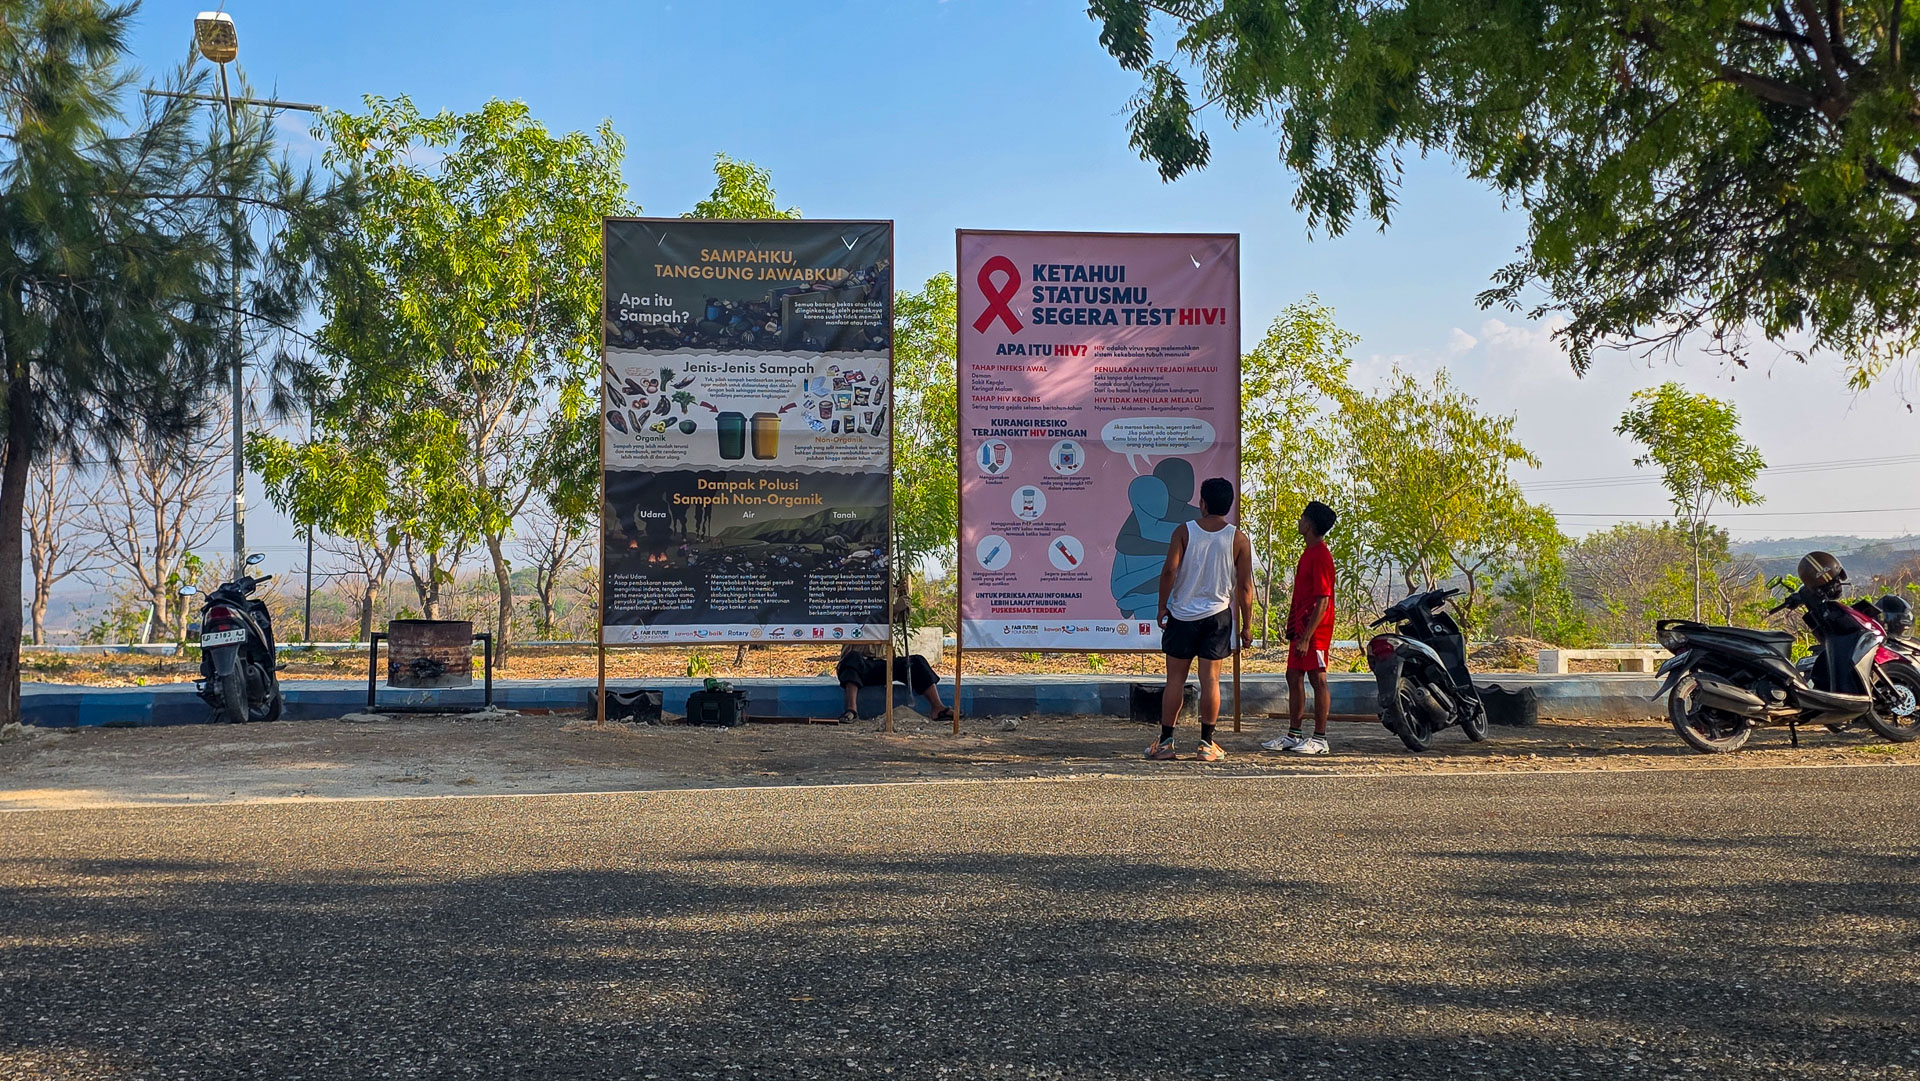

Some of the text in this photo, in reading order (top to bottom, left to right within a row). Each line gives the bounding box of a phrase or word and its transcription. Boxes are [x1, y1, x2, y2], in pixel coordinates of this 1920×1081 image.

[701, 249, 797, 266] SAMPAHKU,
[655, 264, 842, 281] TANGGUNG JAWABKU!
[1033, 264, 1125, 282] KETAHUI
[619, 293, 673, 309] Apa itu
[1032, 286, 1153, 306] STATUSMU,
[620, 310, 689, 325] Sampah?
[1032, 307, 1226, 325] SEGERA TEST HIV!
[996, 344, 1087, 356] APA ITU HIV?
[683, 362, 814, 377] Jenis-Jenis Sampah
[991, 419, 1033, 427] KURANGI
[816, 436, 863, 444] Non-Organik
[972, 429, 1028, 437] TERJANGKIT
[1030, 429, 1047, 437] HIV
[698, 479, 799, 493] Dampak Polusi
[673, 493, 823, 507] Sampah Non-Organik
[640, 511, 666, 519] Udara
